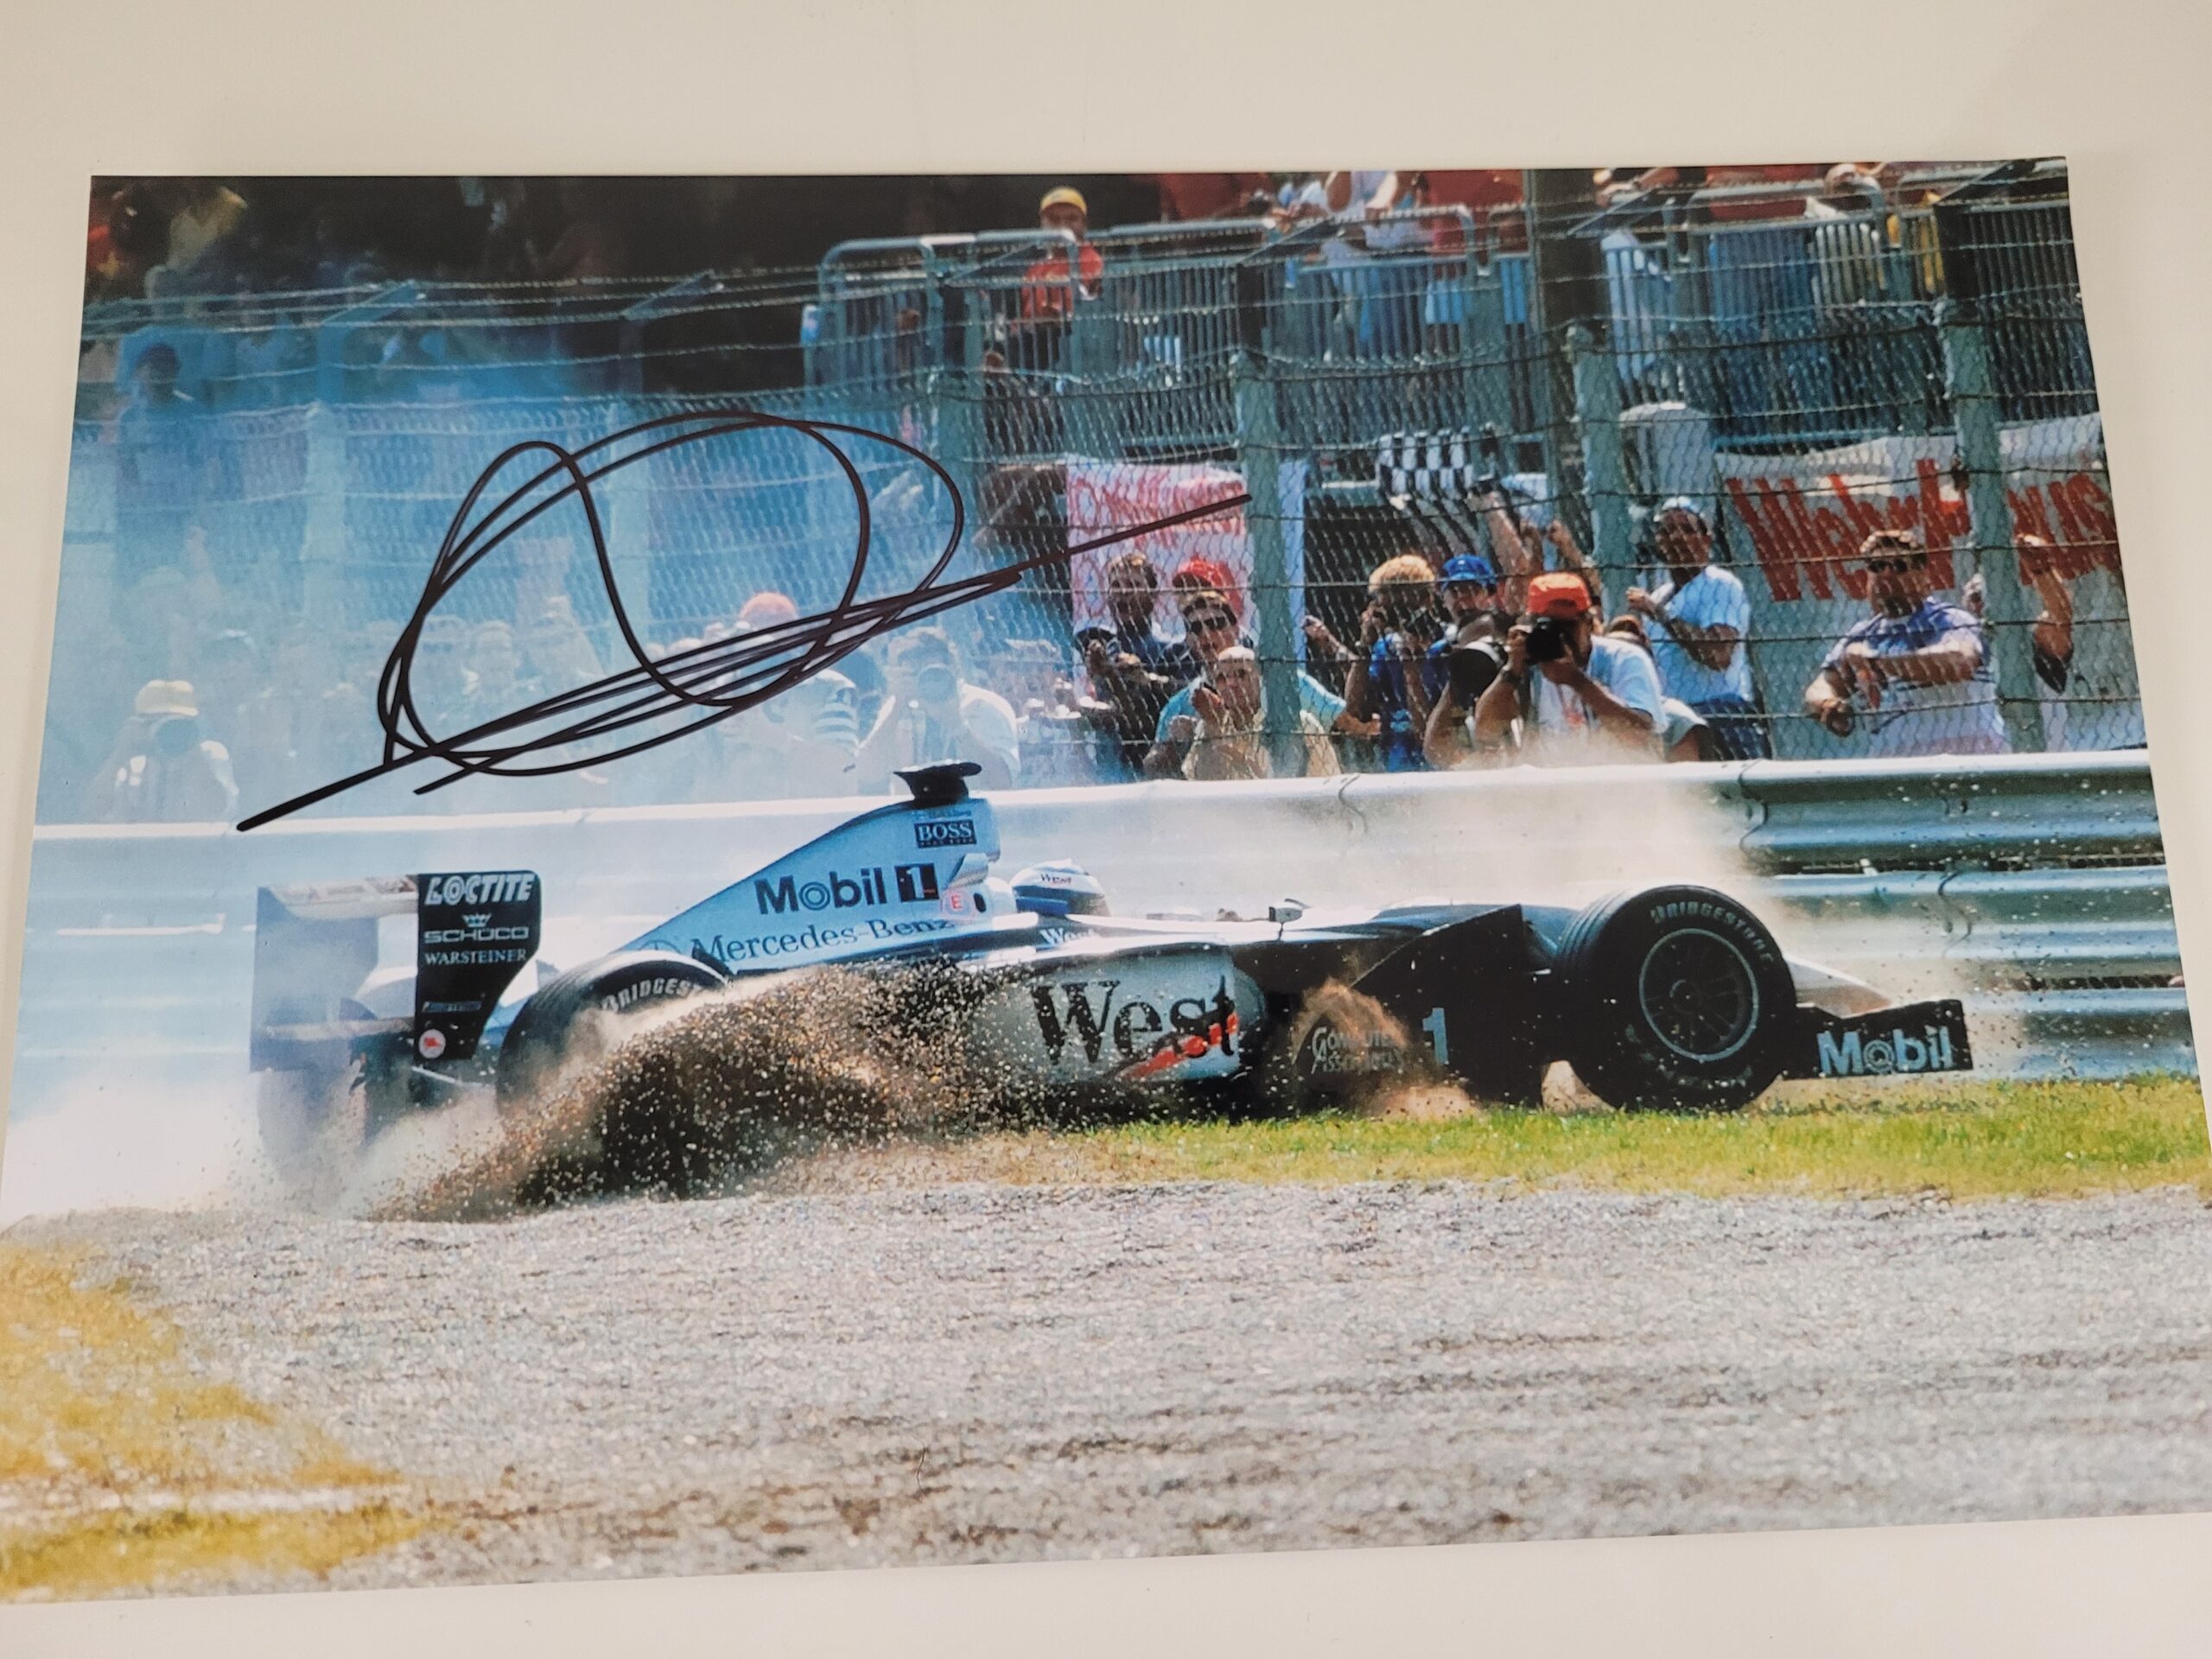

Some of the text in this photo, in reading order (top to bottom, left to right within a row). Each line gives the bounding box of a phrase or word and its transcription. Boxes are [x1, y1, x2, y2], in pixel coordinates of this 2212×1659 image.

[918, 822, 972, 841] BOSS
[424, 873, 535, 906] LOCTITE
[754, 867, 887, 915] Mobil
[423, 948, 528, 966] WARSTEINER
[1031, 974, 1238, 1065] West
[1421, 1007, 1449, 1065] 1
[1817, 1025, 1954, 1077] Mobil
